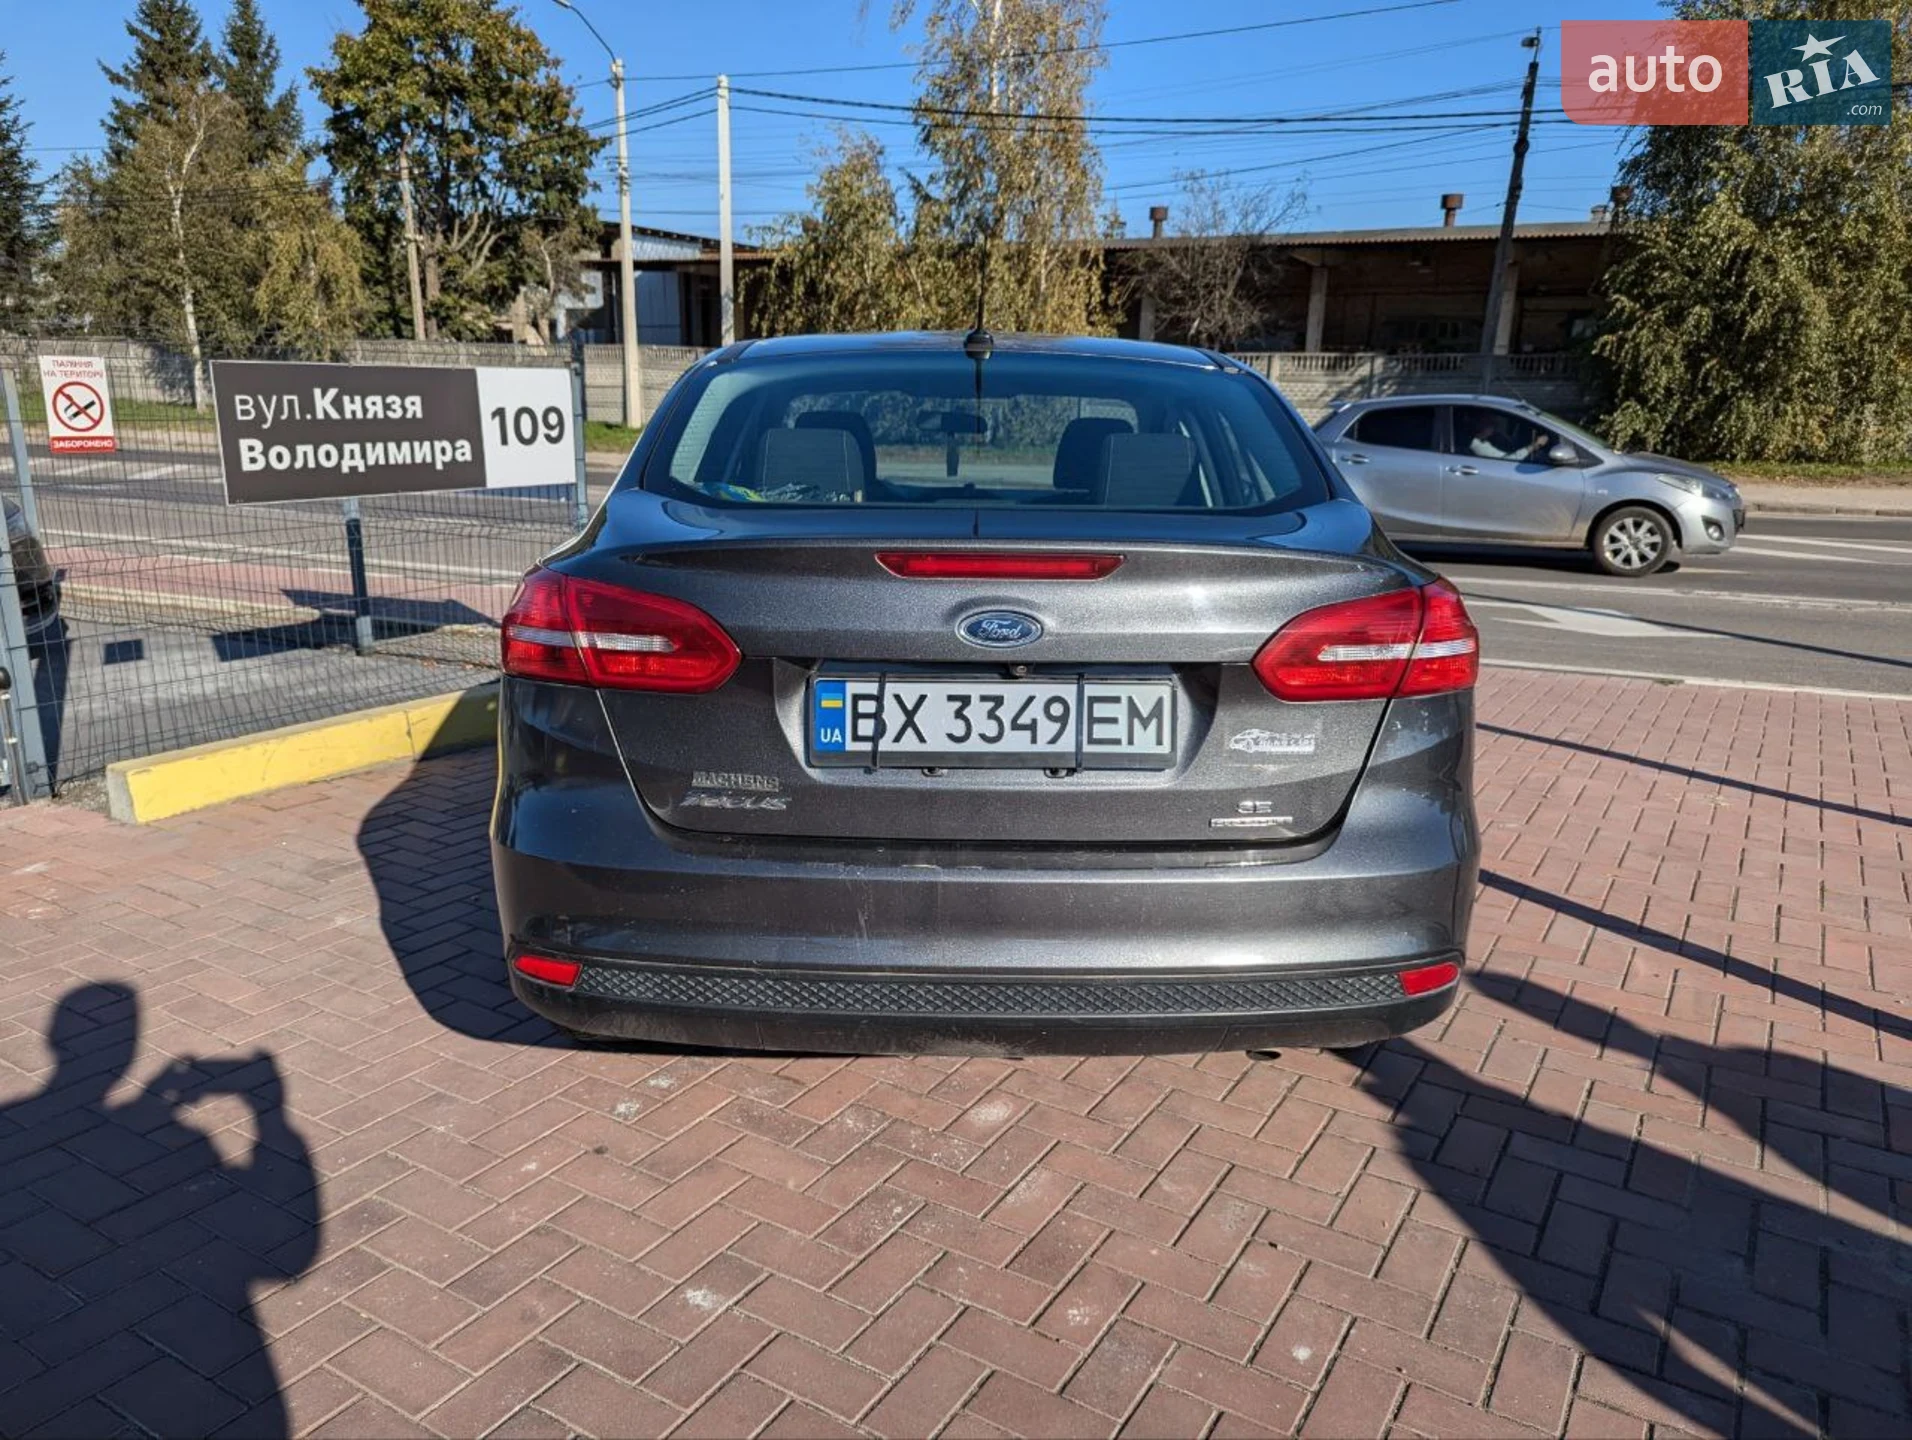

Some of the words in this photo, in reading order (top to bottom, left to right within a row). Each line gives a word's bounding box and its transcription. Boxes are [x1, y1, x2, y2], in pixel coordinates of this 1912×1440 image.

[491, 405, 565, 446] 109
[53, 439, 113, 449] ЗАБОРОНЕНО
[238, 438, 472, 474] Володимира
[979, 619, 1022, 638] Ford
[821, 728, 842, 743] UA
[945, 694, 1071, 745] 3349
[1087, 695, 1165, 746] EM
